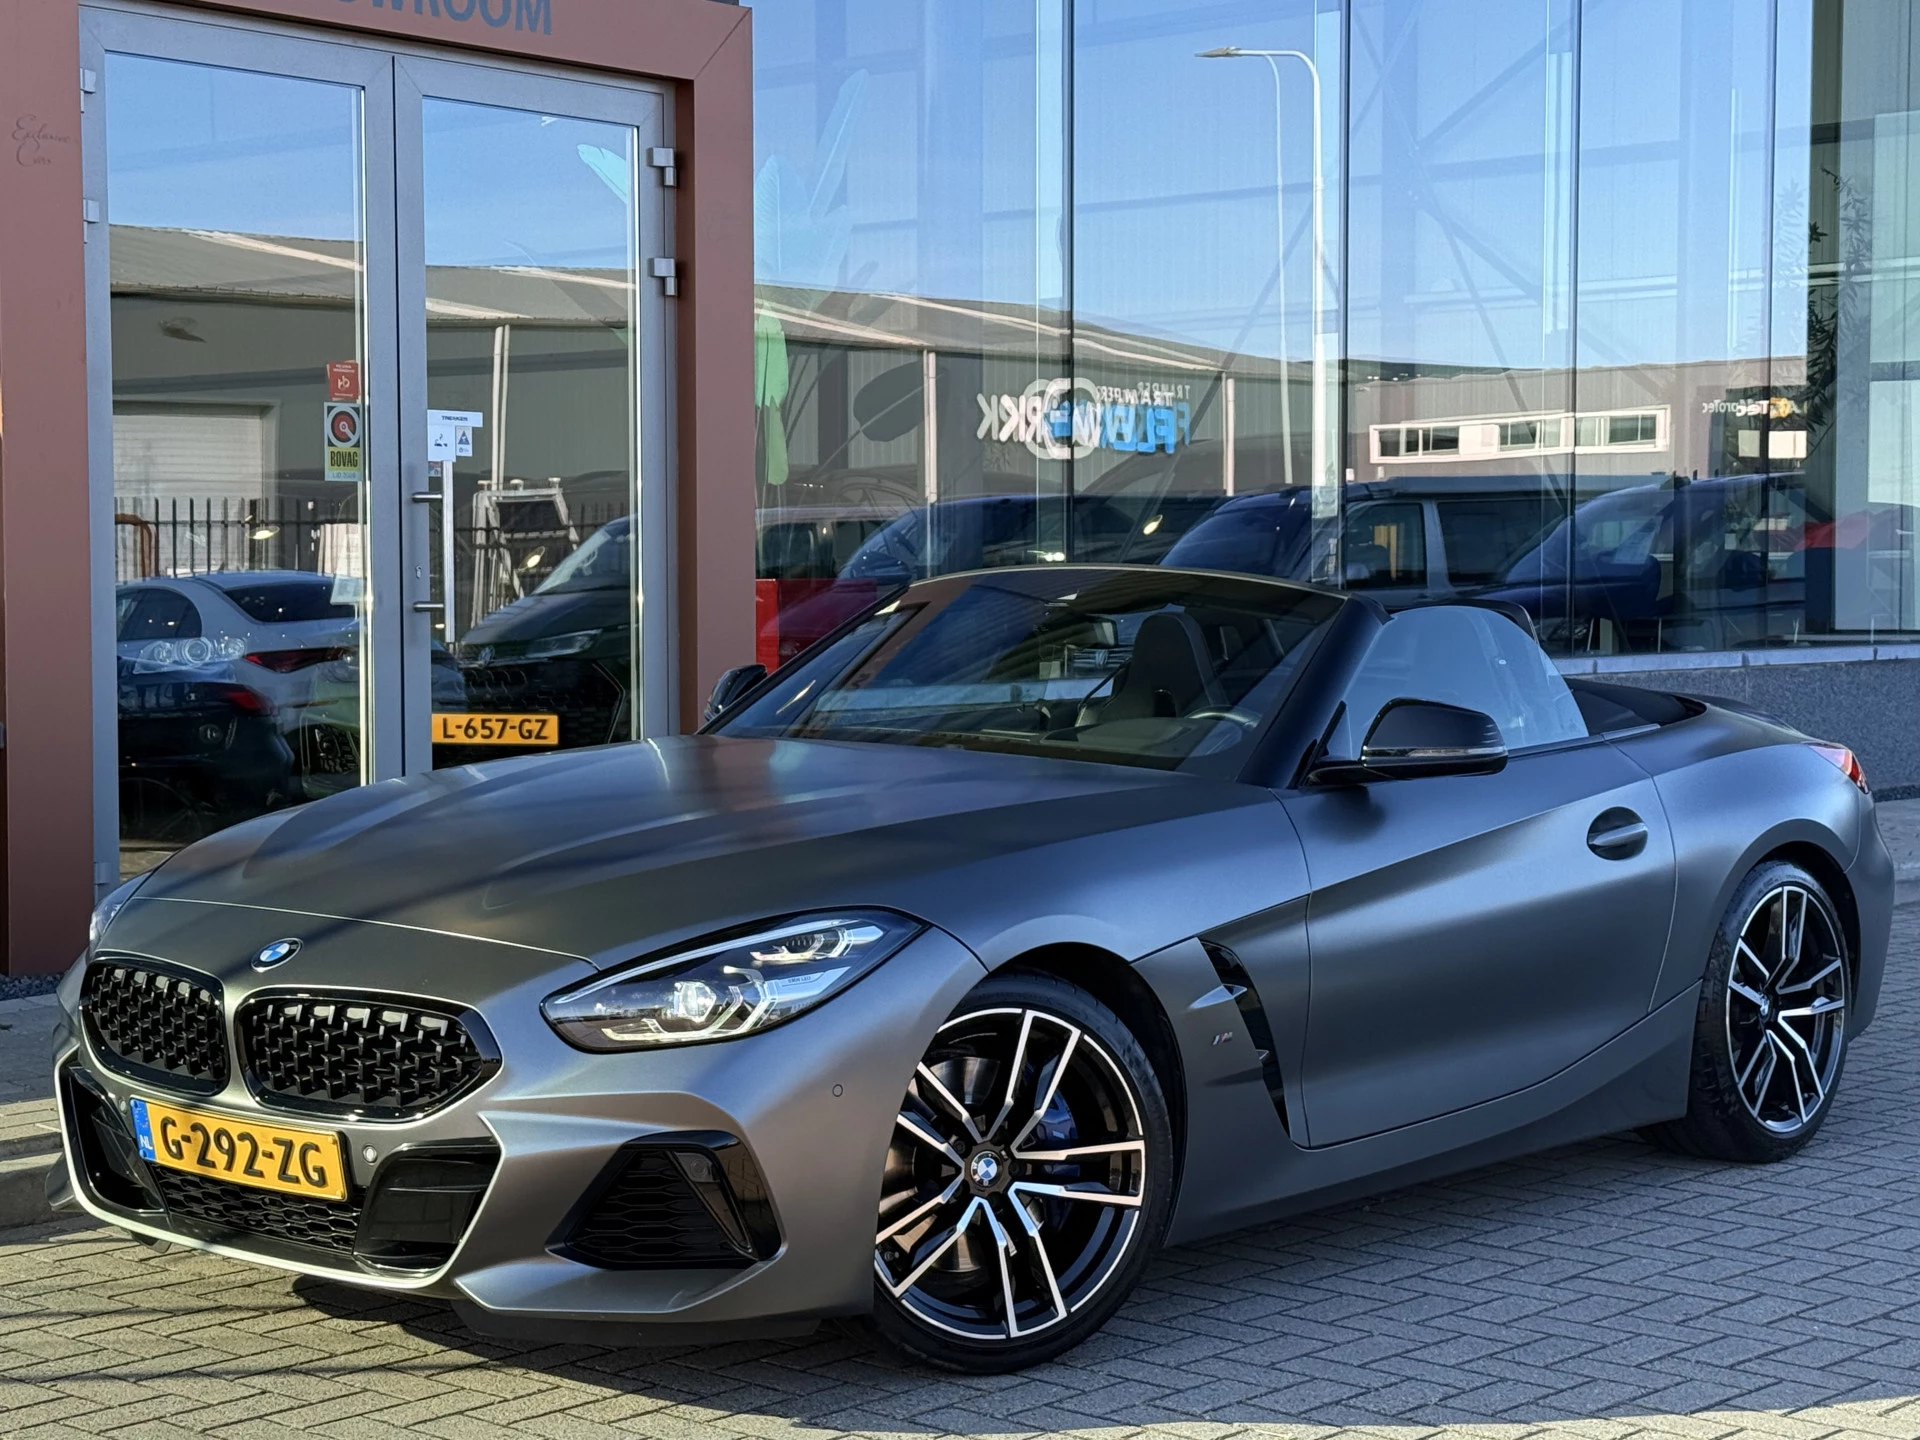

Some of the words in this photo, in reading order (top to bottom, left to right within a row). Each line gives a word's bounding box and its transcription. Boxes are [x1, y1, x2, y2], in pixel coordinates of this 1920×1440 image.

[330, 451, 359, 467] BOVAG
[442, 718, 549, 740] L-657-GZ
[160, 1116, 329, 1188] G-292-ZG
